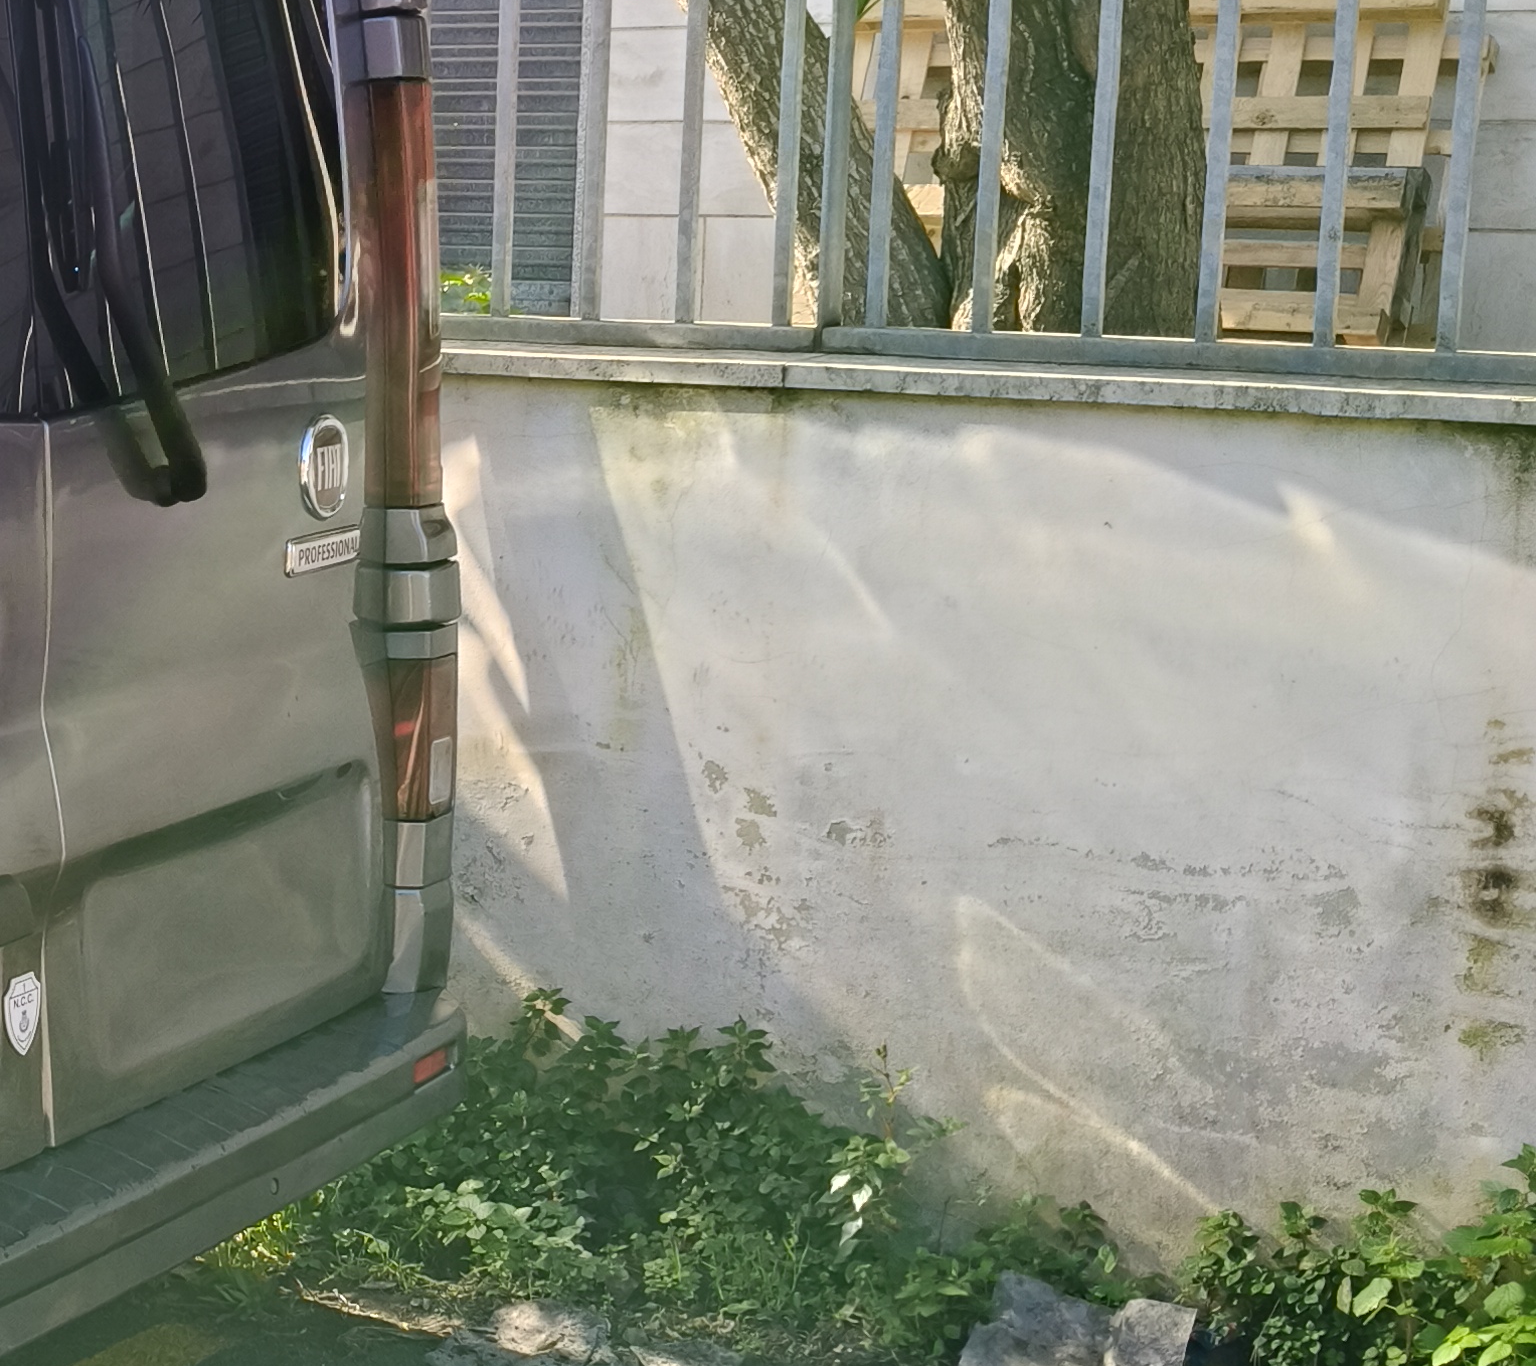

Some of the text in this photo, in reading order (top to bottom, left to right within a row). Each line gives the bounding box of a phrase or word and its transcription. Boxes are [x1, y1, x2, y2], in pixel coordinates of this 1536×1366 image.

[316, 443, 342, 491] FIAT
[298, 535, 360, 567] PROFESSIONAL
[13, 993, 35, 1010] N.C.C.
